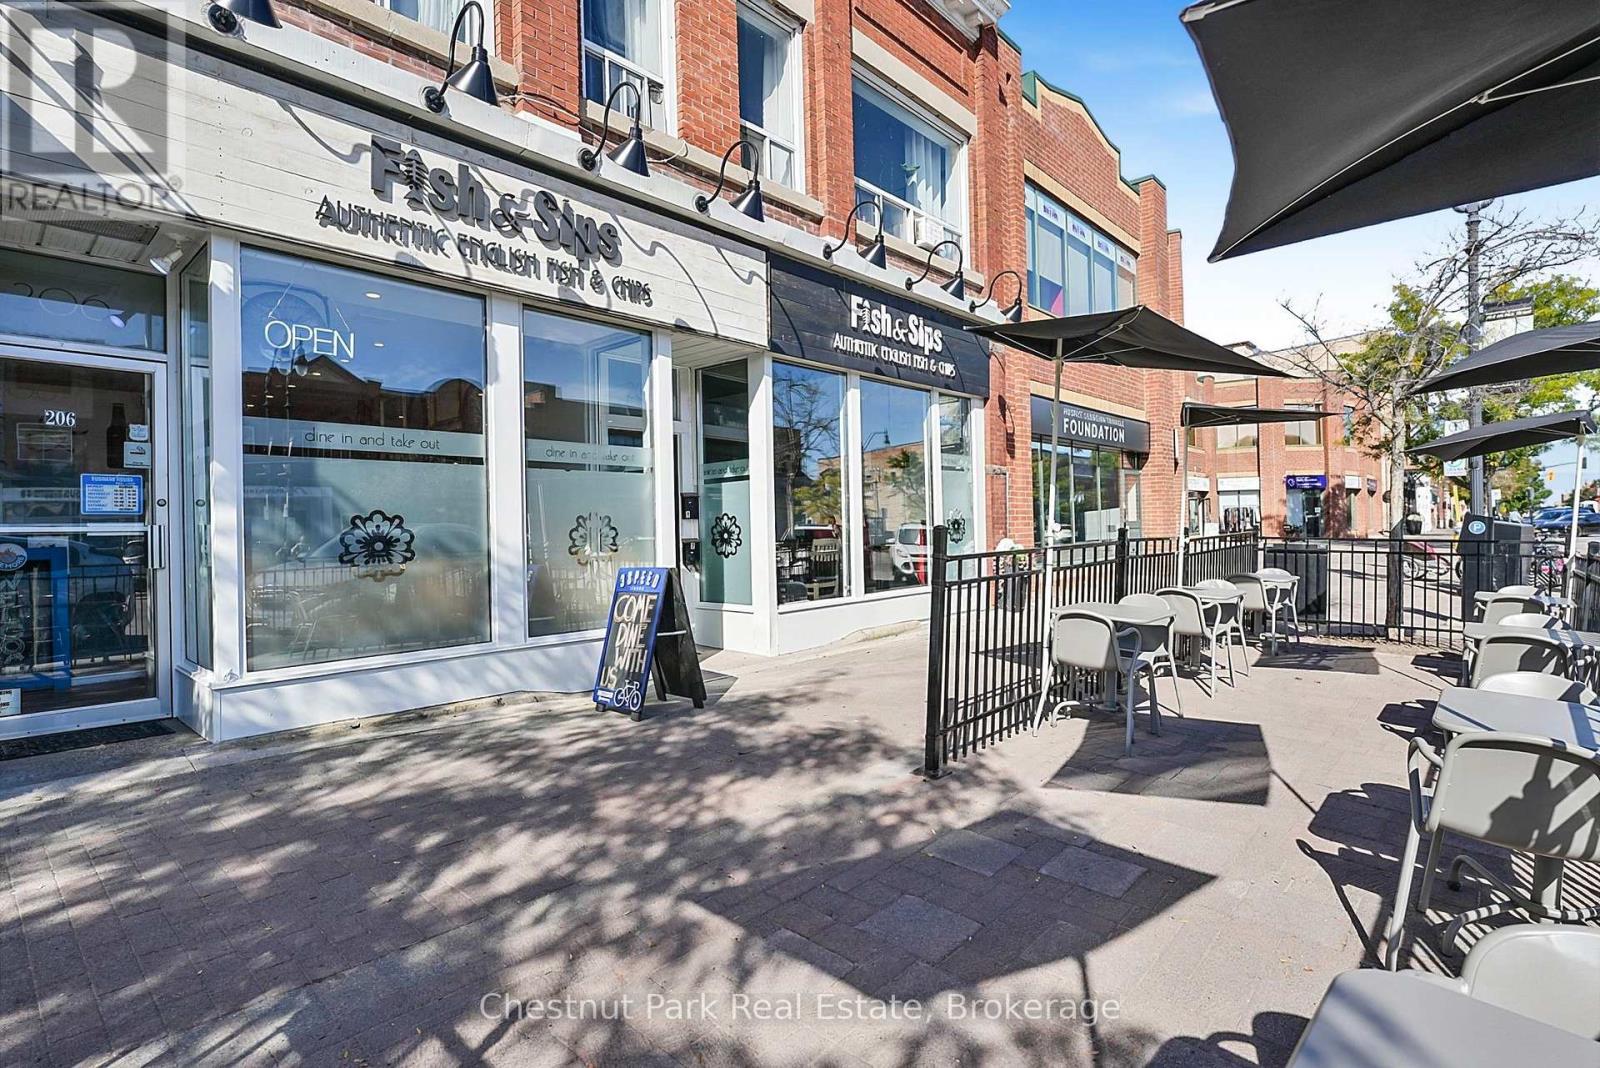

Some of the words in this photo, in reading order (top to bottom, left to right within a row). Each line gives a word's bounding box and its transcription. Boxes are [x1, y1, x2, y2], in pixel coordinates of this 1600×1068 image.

[491, 193, 531, 238] &
[534, 191, 620, 261] Sips
[315, 194, 447, 251] AUTHENTIC
[590, 269, 605, 295] &
[850, 294, 892, 339] Fish
[892, 318, 909, 342] &
[908, 312, 943, 355] Sips
[265, 319, 355, 360] OPEN
[44, 409, 77, 427] 206
[1063, 417, 1125, 443] FOUNDATION
[304, 426, 335, 443] dine
[341, 432, 353, 444] in
[359, 432, 385, 446] and
[391, 433, 415, 449] take
[420, 440, 441, 450] out
[614, 594, 658, 623] COME
[615, 622, 648, 649] DINE
[614, 647, 648, 673] WITH
[601, 666, 618, 689] US
